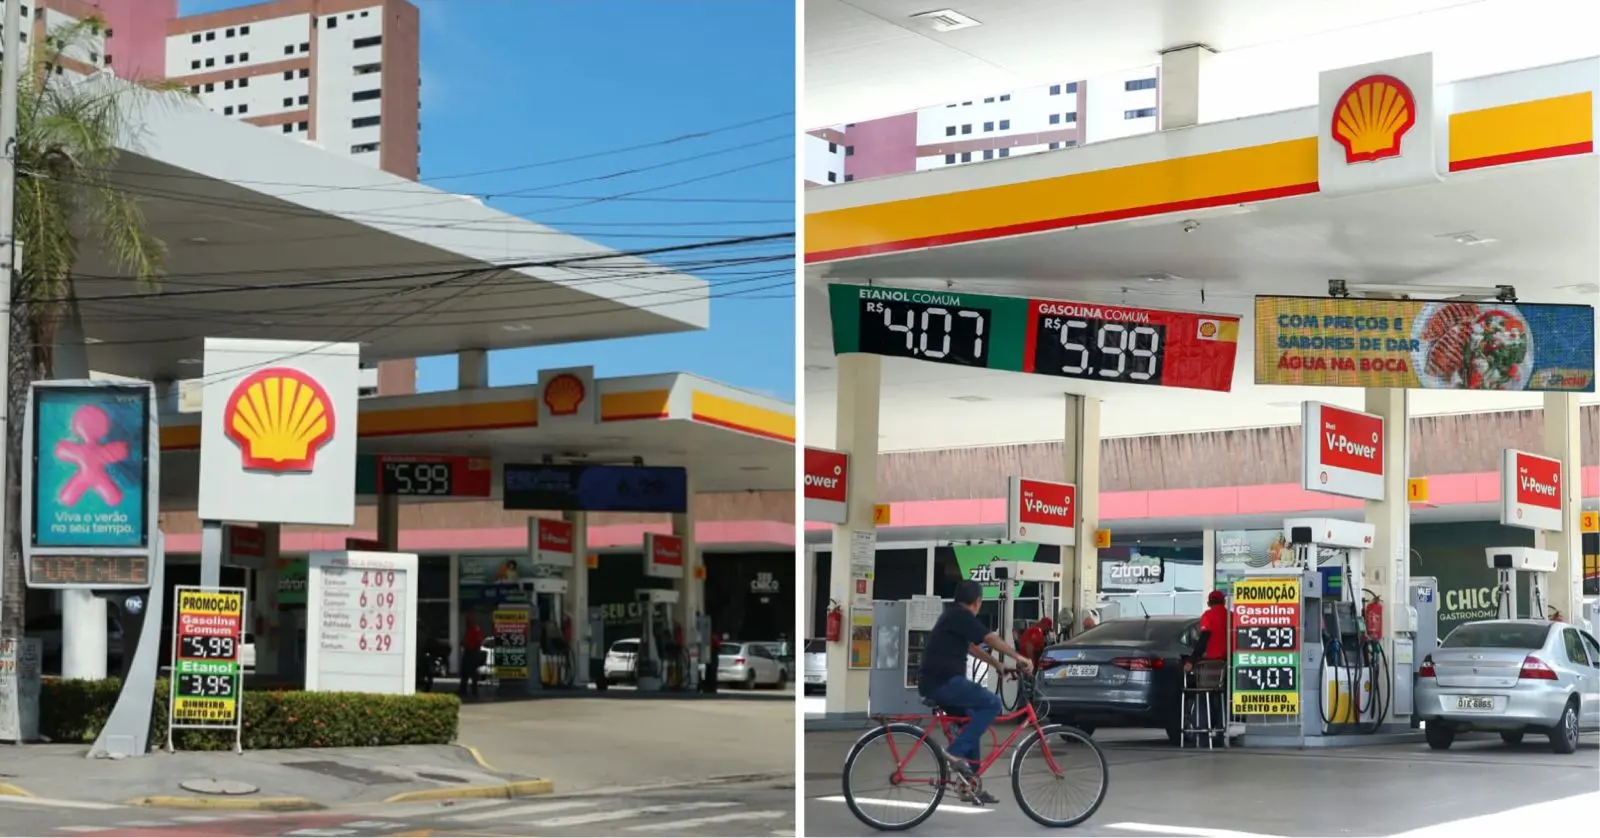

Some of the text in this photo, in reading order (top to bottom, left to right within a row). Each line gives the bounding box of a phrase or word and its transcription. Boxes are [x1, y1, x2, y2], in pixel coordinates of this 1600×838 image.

[859, 288, 960, 307] ETANOL COMUM
[866, 302, 884, 314] R$
[1038, 303, 1149, 323] GASOLINA COMUM
[1044, 318, 1061, 330] R$
[1277, 314, 1403, 332] COM PREÇOS E
[1277, 335, 1420, 352] SABORES DE DAR
[1277, 352, 1409, 373] ÁGUA NA BOCA
[1326, 432, 1376, 459] V-Power
[1412, 484, 1417, 496] 1
[1520, 475, 1557, 496] V-Power
[876, 508, 883, 520] 7
[1024, 498, 1069, 516] V-Power
[55, 511, 128, 523] Viva o verão
[1584, 516, 1592, 527] 3
[51, 523, 134, 536] no seu tempo.
[1111, 561, 1161, 577] zitrone
[1236, 584, 1295, 602] PROMOÇÃO
[183, 597, 237, 613] PROMOÇÃO
[1236, 605, 1295, 615] Gasolina
[181, 615, 236, 626] Gasolina
[1240, 615, 1290, 624] Comum
[185, 625, 232, 634] Comum
[1248, 627, 1293, 650] 5,99
[191, 636, 234, 658] 5,99
[181, 661, 232, 672] Etanol
[1238, 653, 1294, 665] Etanol
[191, 674, 231, 696] 3,95
[1248, 667, 1293, 690] 4,07
[1281, 704, 1296, 712] PIX
